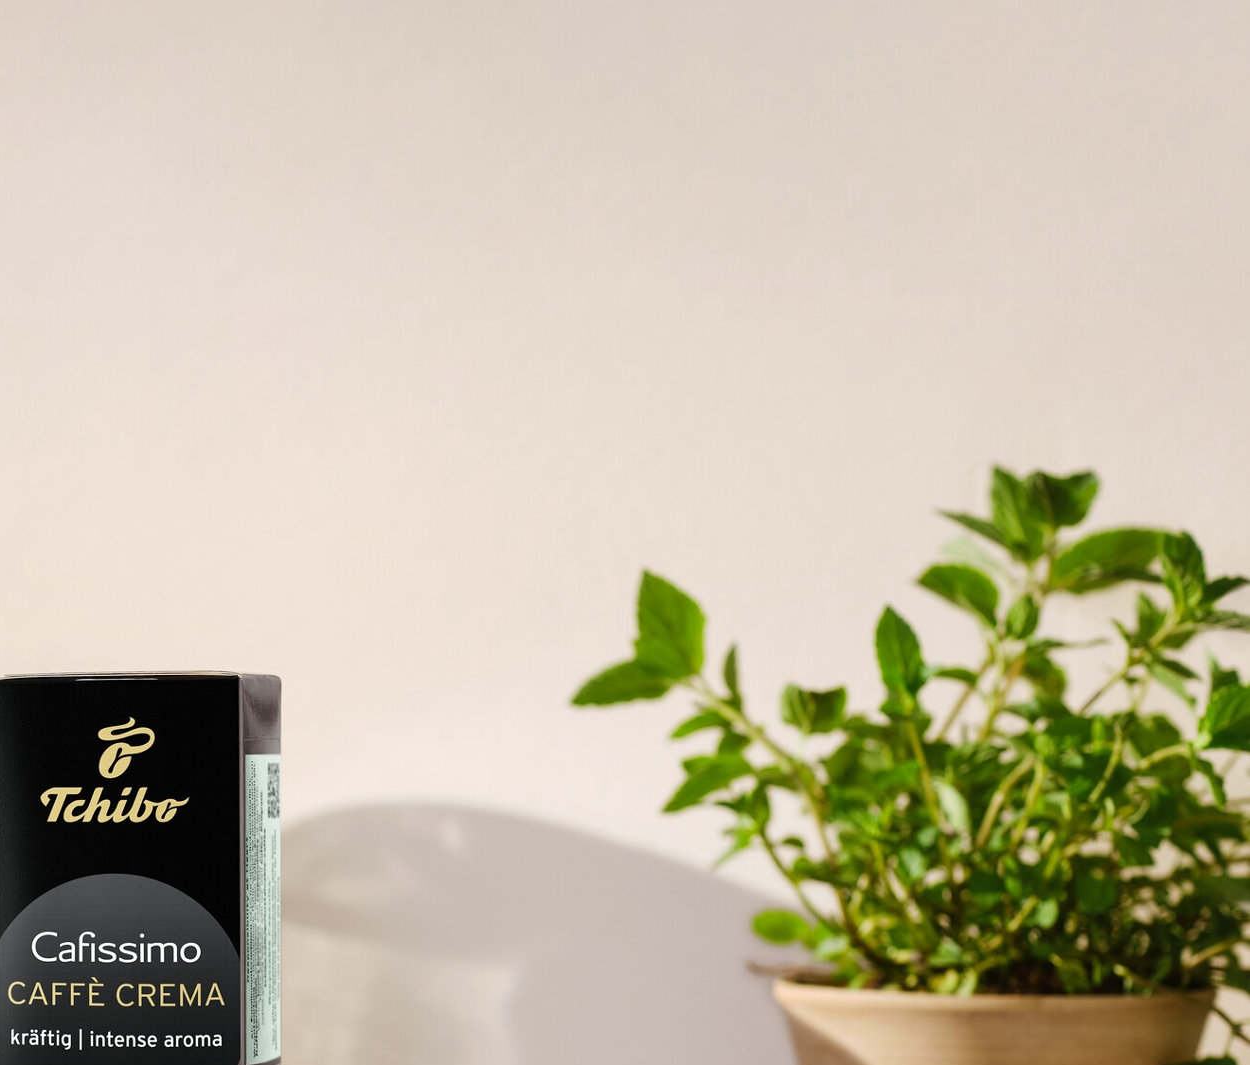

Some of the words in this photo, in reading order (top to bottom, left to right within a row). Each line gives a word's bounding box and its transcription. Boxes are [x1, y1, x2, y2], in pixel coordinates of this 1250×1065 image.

[40, 786, 189, 823] Tchibo
[31, 931, 202, 963] Cafissimo
[7, 976, 105, 1007] CAFFÈ
[115, 982, 226, 1007] CREMA
[10, 1028, 72, 1050] kräftig
[89, 1030, 158, 1048] intense
[164, 1033, 223, 1047] aroma
